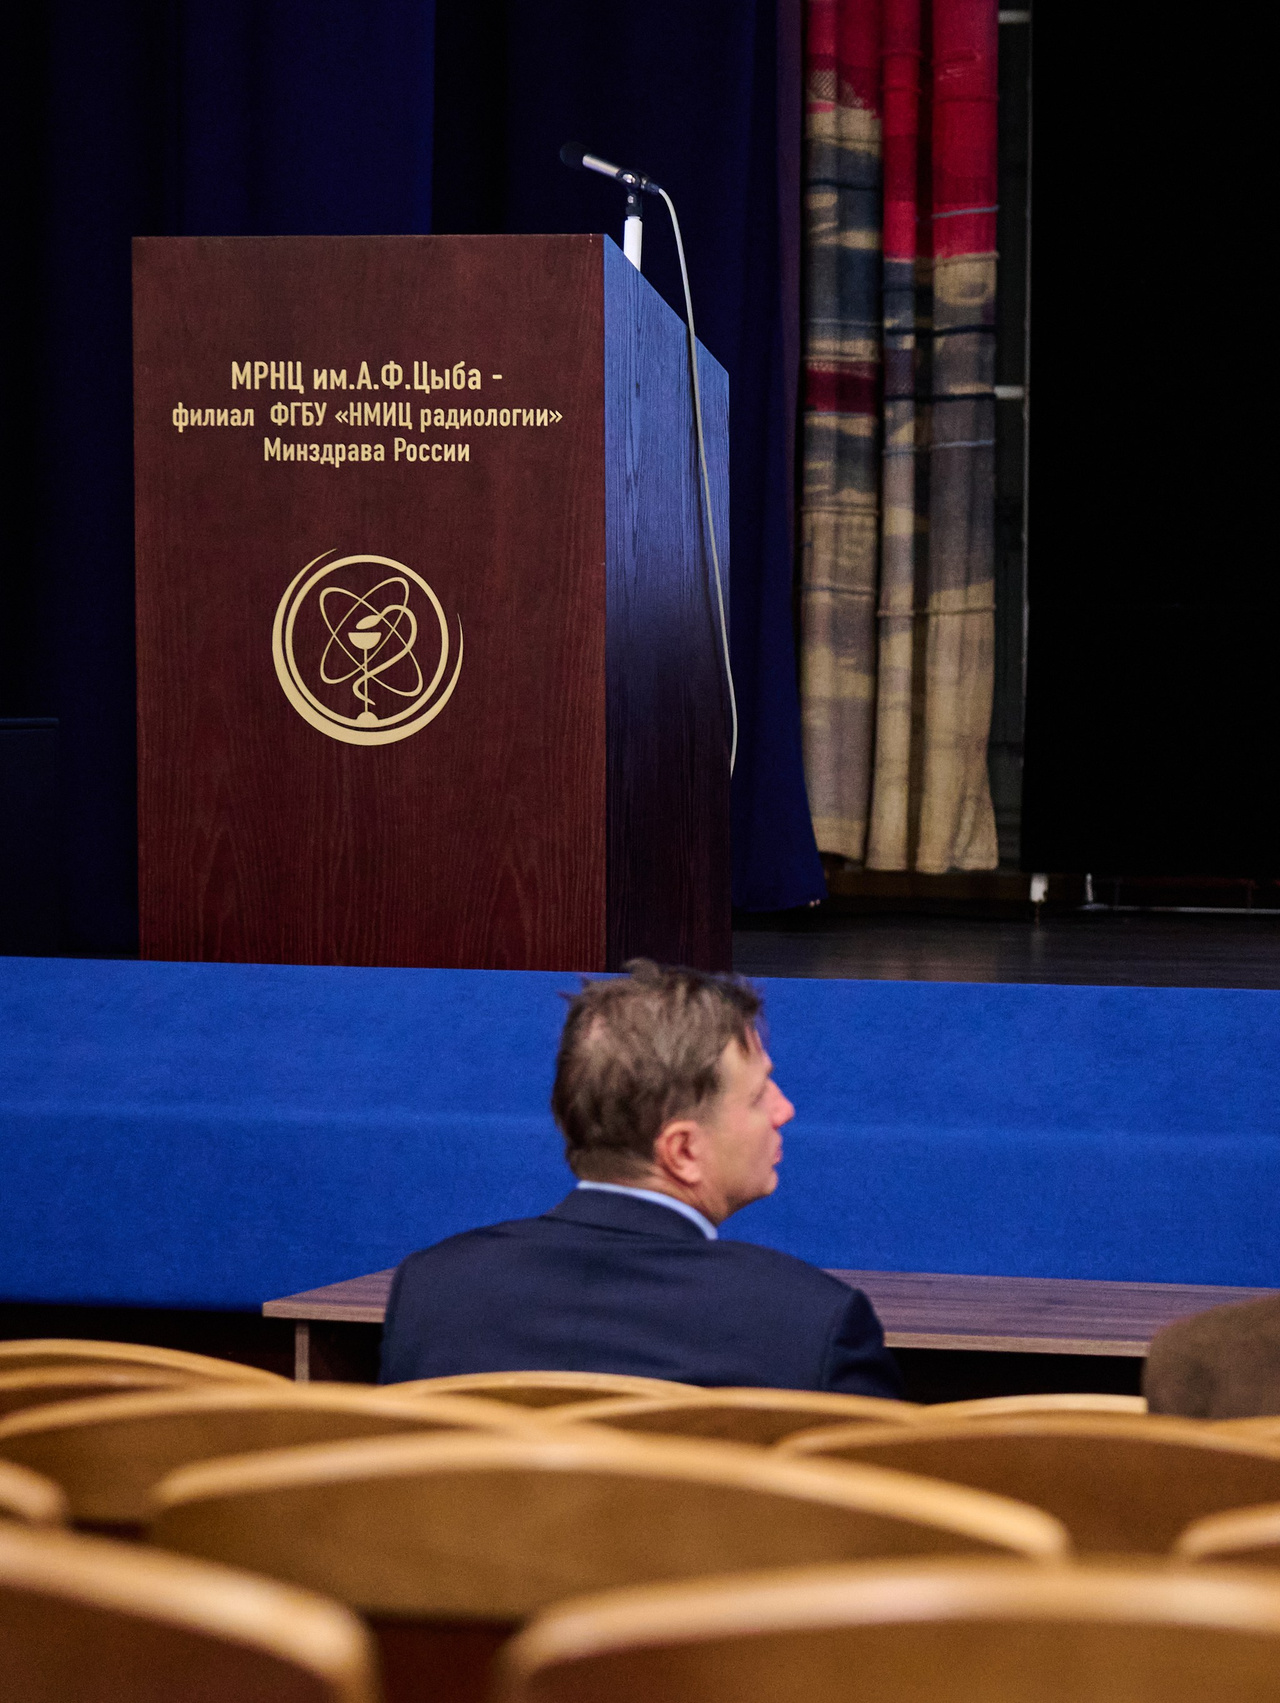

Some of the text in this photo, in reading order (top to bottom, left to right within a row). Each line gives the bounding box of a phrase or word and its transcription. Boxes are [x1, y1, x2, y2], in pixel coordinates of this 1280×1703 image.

[231, 360, 305, 394] МРНЦ
[172, 401, 563, 432] филиал ФГБУ «НМИЦ радиологии»
[264, 437, 470, 468] Минздрава России
